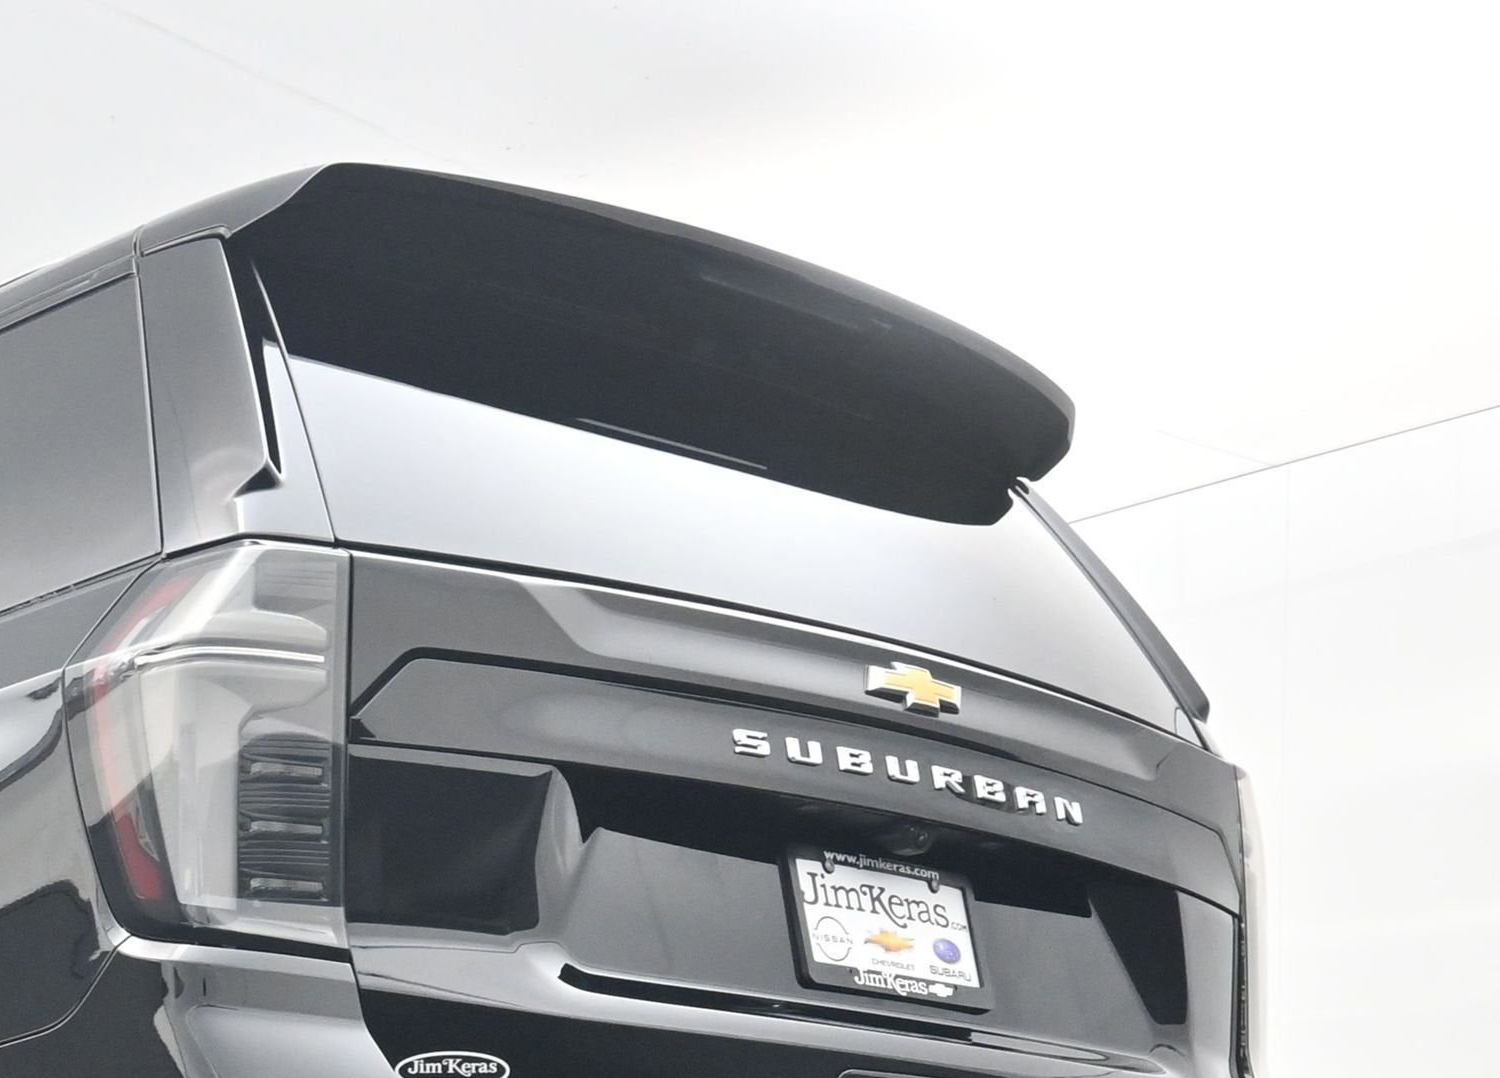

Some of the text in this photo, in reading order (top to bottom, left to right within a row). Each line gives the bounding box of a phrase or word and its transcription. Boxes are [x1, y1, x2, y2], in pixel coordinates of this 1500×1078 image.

[732, 728, 1084, 826] SUBURBAN
[823, 850, 940, 880] www.jimkeras.com
[812, 933, 854, 945] NISSAN
[929, 964, 973, 982] SUBARU
